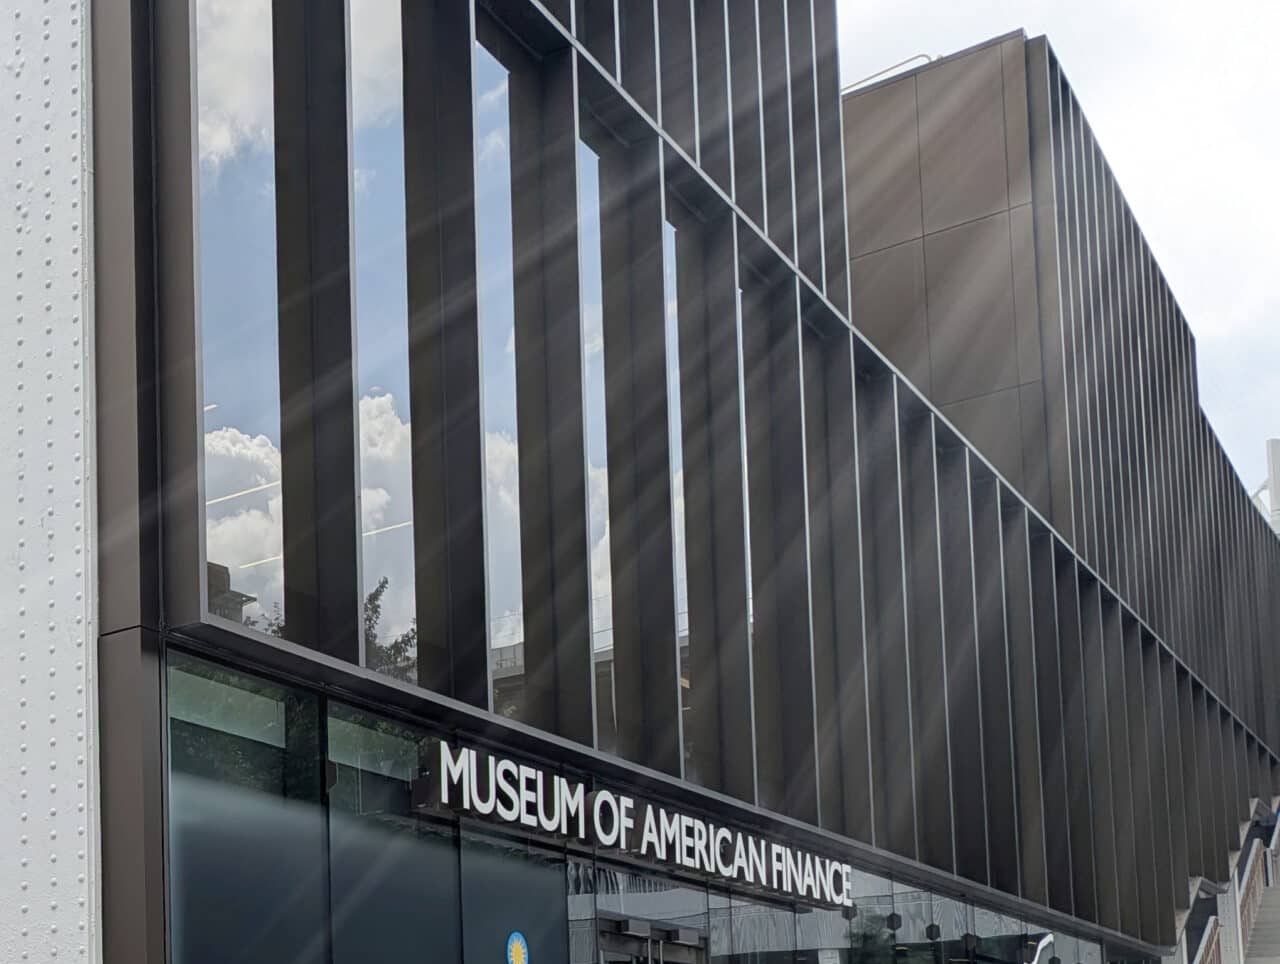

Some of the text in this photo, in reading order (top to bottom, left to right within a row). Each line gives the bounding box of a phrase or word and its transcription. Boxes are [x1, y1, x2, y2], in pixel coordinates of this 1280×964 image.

[440, 740, 853, 907] MUSEUM OF AMERICAN FINANCE
